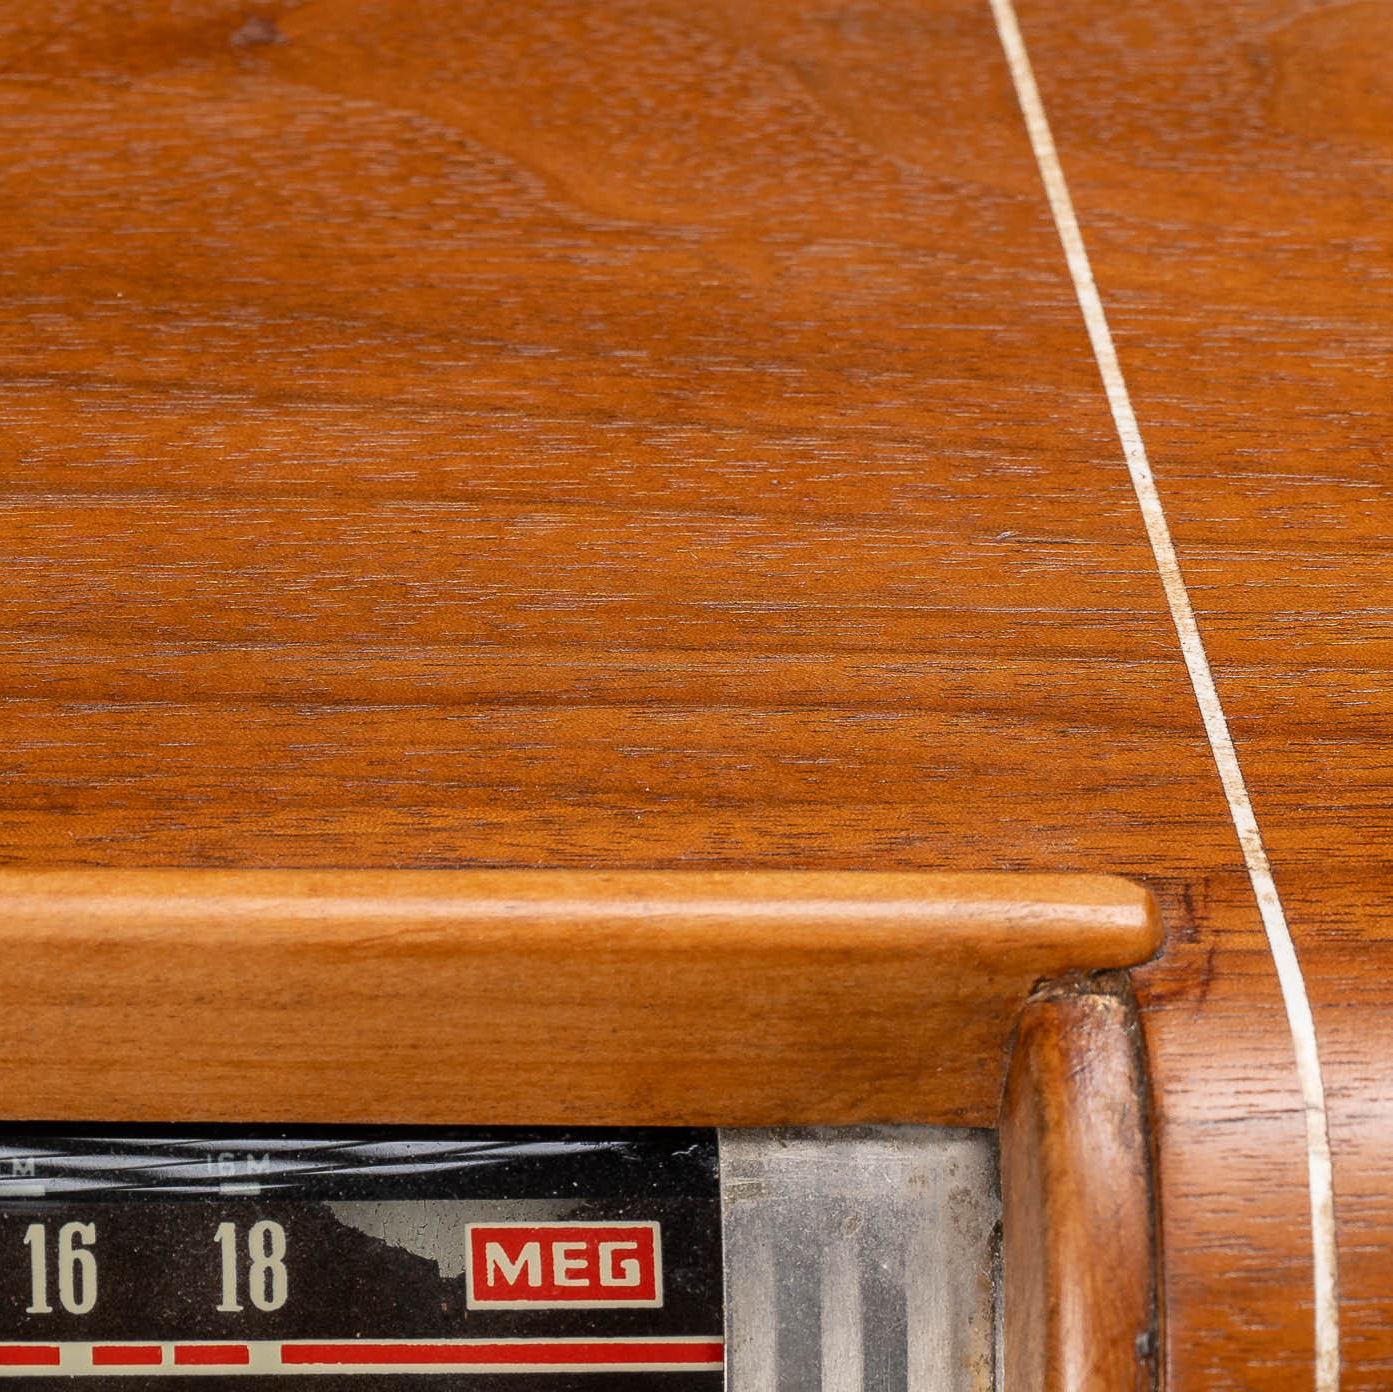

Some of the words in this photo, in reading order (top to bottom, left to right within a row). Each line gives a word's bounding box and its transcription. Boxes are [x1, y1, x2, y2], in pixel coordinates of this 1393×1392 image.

[23, 1220, 98, 1315] 16
[213, 1220, 289, 1313] 18
[484, 1241, 643, 1288] MEG
